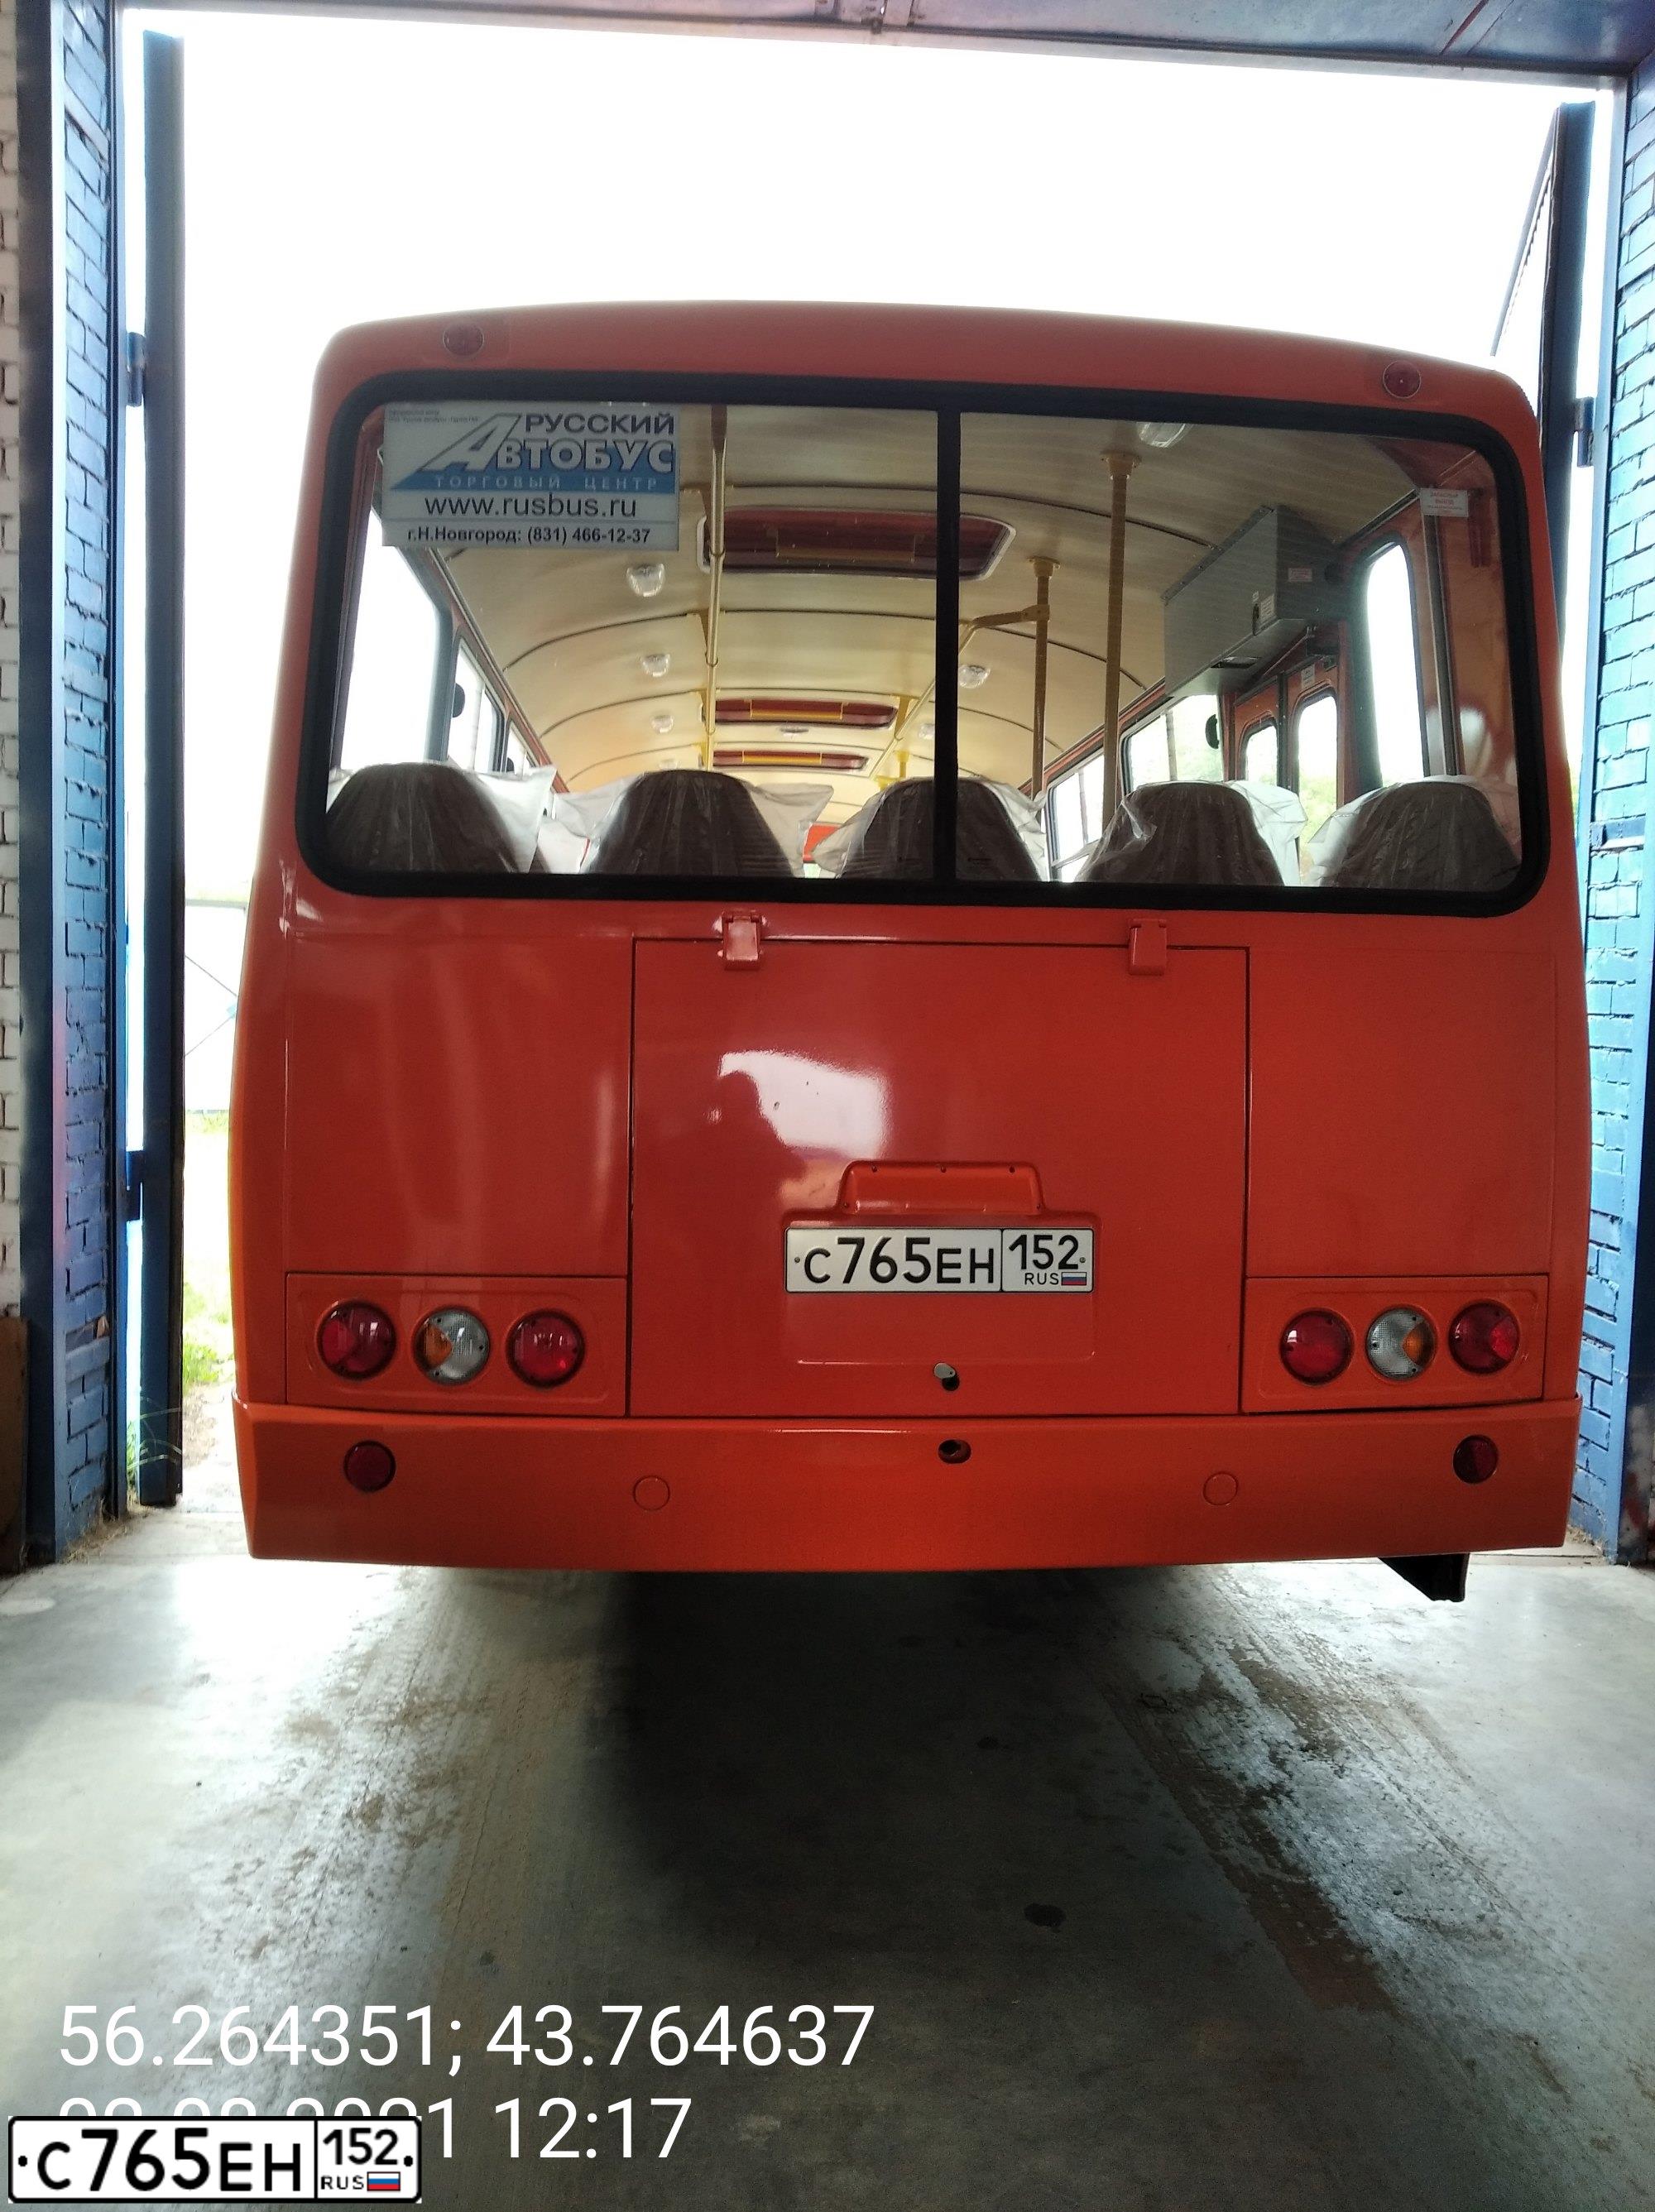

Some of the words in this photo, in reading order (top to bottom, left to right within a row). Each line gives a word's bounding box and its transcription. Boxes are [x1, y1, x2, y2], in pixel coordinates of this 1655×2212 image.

[525, 413, 674, 434] РУССКИЙ
[417, 413, 674, 474] АВТОБУС
[435, 475, 561, 489] ТОРГОВЫЙ
[584, 477, 657, 491] ЦЕНТР
[425, 492, 636, 518] www.rusbus.ru
[527, 526, 568, 546] (831)
[572, 528, 651, 544] 466-12-37
[1008, 1234, 1080, 1271] 152
[1024, 1273, 1059, 1286] RUS
